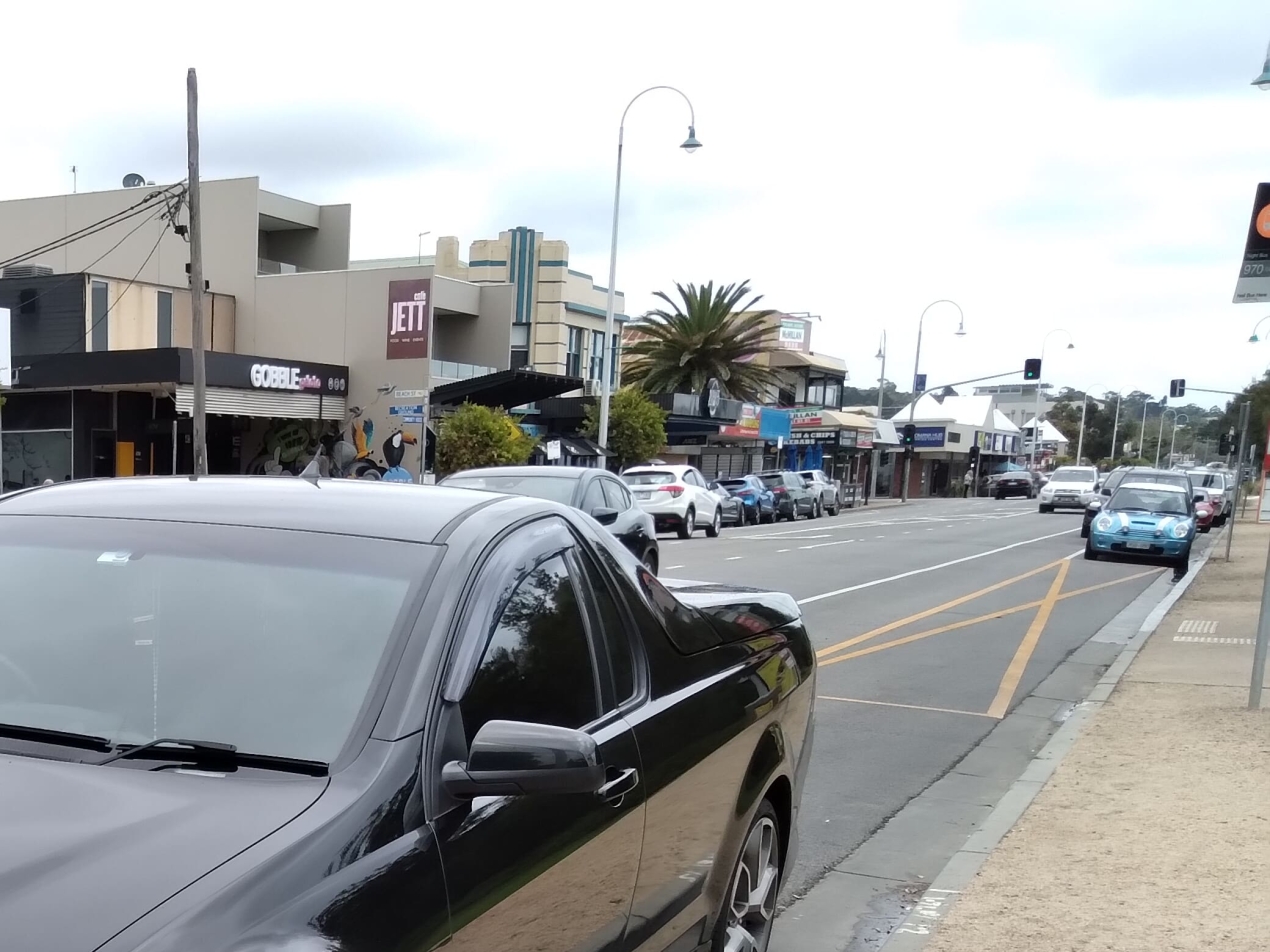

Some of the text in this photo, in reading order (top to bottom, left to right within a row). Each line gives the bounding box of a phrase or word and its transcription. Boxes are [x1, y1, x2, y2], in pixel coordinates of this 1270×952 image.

[1243, 264, 1264, 275] 970
[390, 301, 426, 335] JETT
[251, 364, 300, 390] GOBBLE
